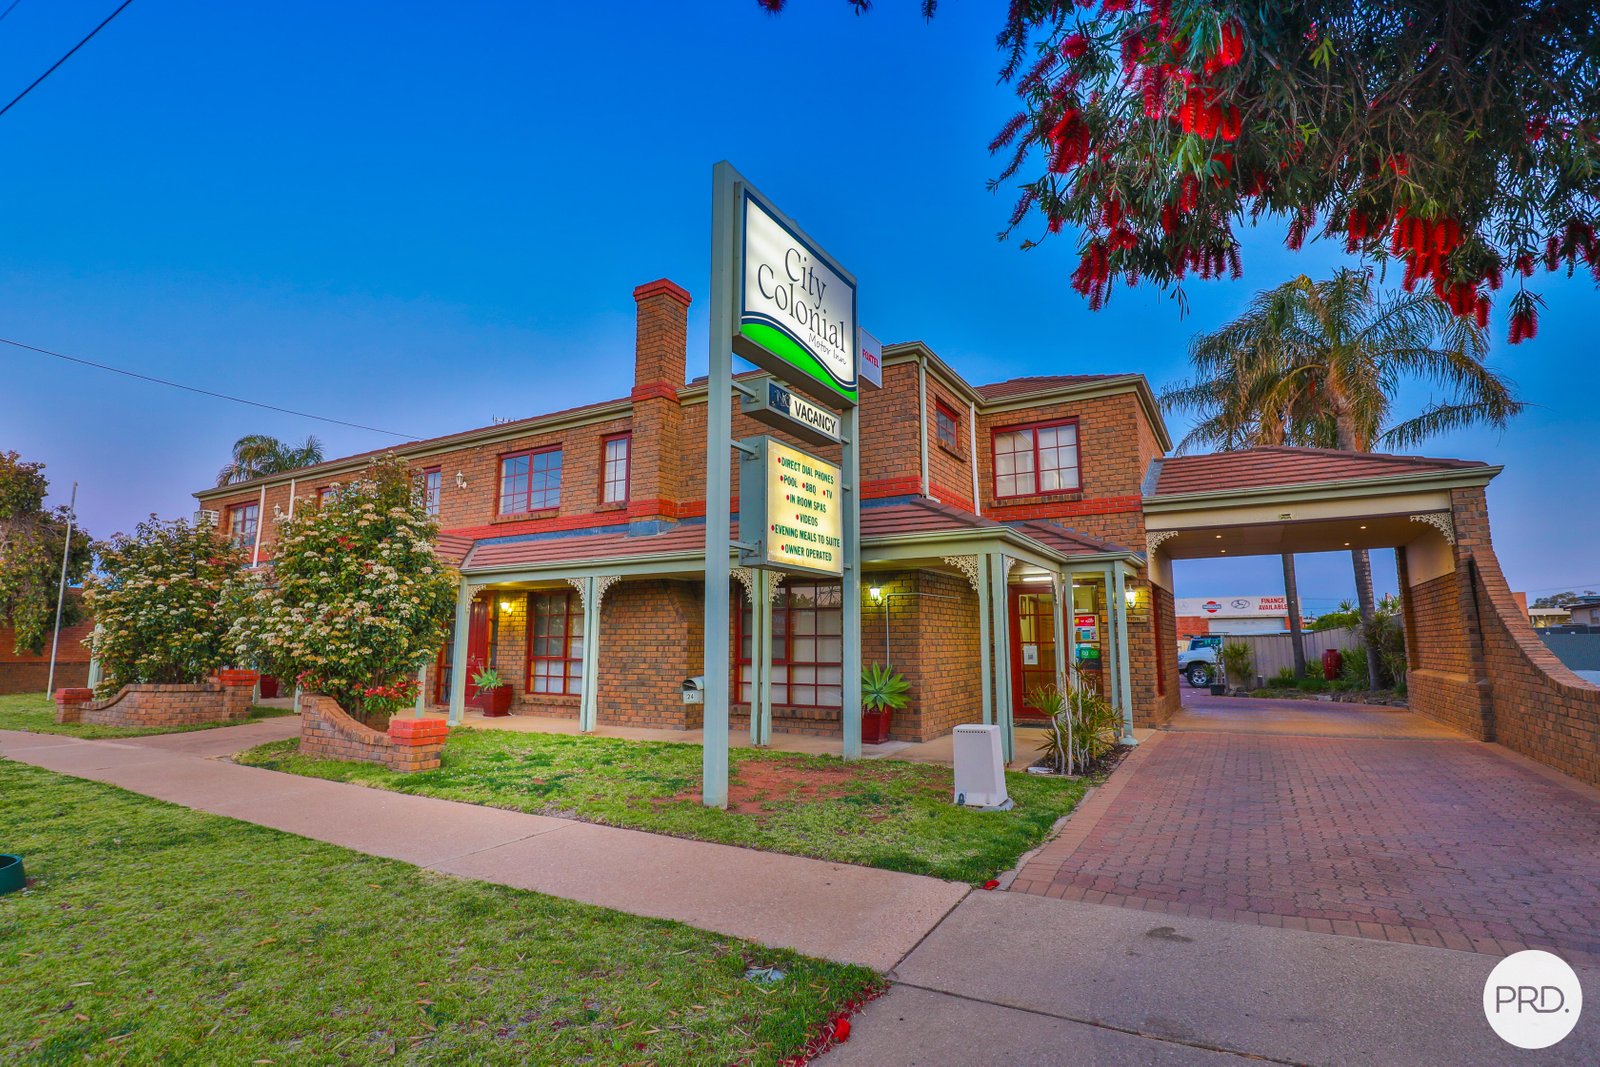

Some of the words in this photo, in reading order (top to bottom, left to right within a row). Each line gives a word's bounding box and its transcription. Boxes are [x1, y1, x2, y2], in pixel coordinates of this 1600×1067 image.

[785, 248, 826, 309] City
[758, 264, 846, 353] Colonial
[809, 332, 831, 355] Motor
[794, 400, 836, 434] VACANCY
[781, 457, 801, 472] DIRECT
[802, 465, 813, 478] DIAL
[815, 470, 834, 485] PHONES
[783, 475, 798, 489] POOL
[805, 482, 817, 496] BBQ
[826, 488, 833, 500] TV
[789, 494, 796, 504] IN
[796, 495, 813, 509] ROOM
[813, 500, 827, 513] SPAS
[800, 514, 818, 527] VIDEOS
[775, 524, 799, 539] EVENING
[799, 530, 817, 543] MEALS
[817, 534, 825, 544] TO
[825, 535, 840, 548] SUITE
[785, 544, 805, 557] OWNER
[806, 548, 832, 561] OPERATED
